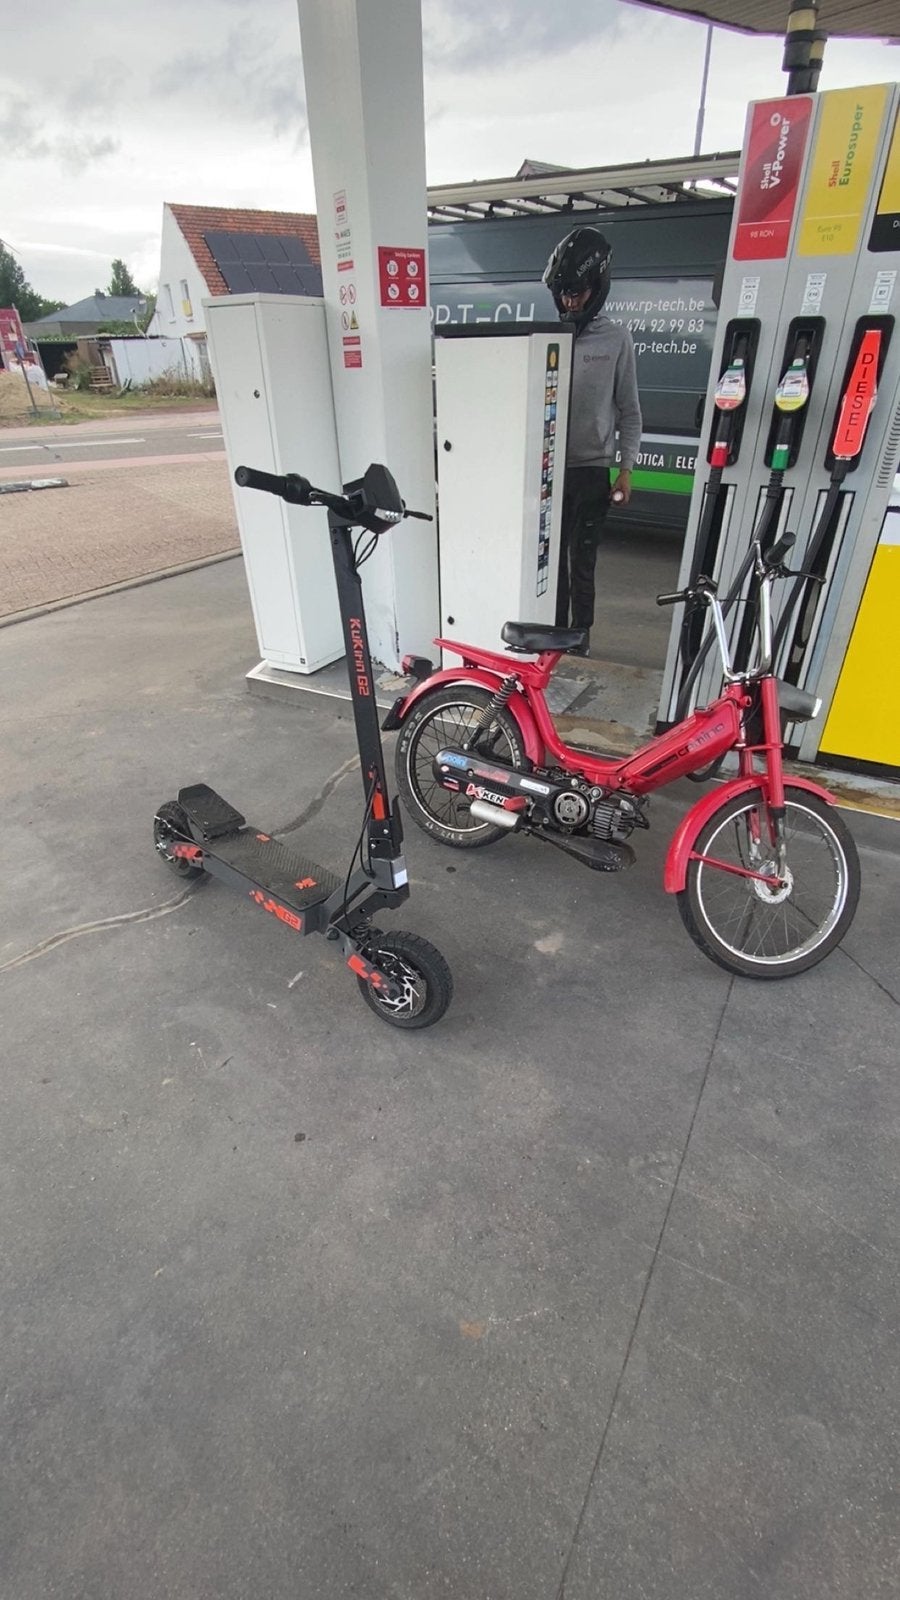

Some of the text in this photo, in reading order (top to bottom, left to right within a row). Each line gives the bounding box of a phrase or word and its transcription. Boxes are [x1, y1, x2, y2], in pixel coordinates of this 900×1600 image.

[768, 117, 791, 189] V-Power
[838, 103, 865, 187] Eurosuper
[760, 162, 772, 190] Shell
[828, 160, 841, 188] Shell
[604, 298, 705, 314] www.rp-tech.be
[626, 318, 646, 333] 474
[651, 318, 666, 333] 92
[670, 318, 685, 333] 99
[688, 318, 705, 333] 83
[633, 340, 697, 356] rp-tech.be
[844, 352, 874, 443] DIESEL
[357, 675, 370, 697] G2
[282, 910, 300, 927] G2
